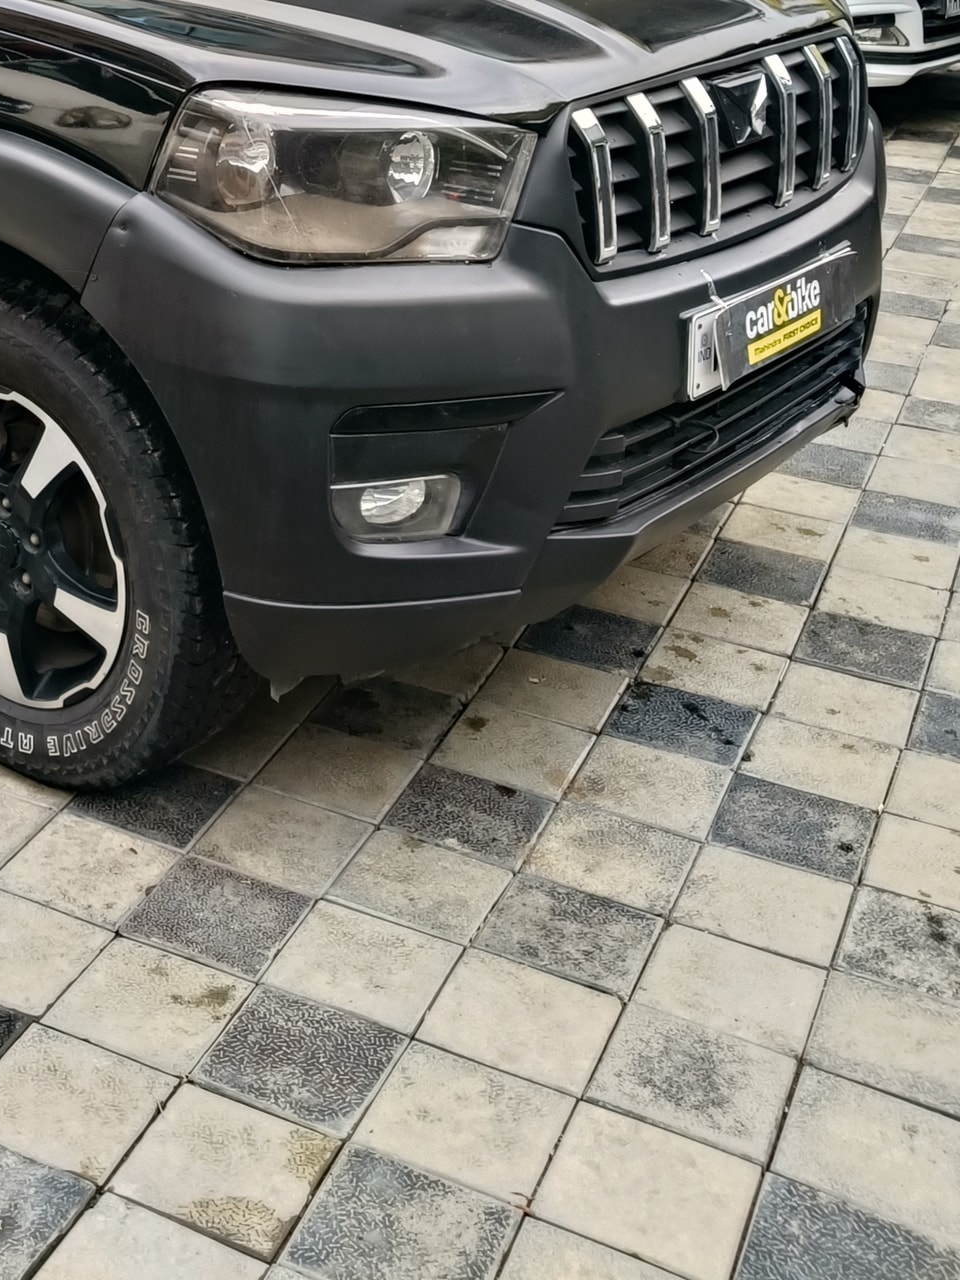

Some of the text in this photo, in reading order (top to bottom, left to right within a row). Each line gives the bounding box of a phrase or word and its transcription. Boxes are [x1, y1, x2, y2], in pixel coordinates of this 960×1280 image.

[745, 277, 820, 339] car&bike
[697, 346, 712, 363] IND
[0, 609, 151, 757] CROSSDRIVE AT
